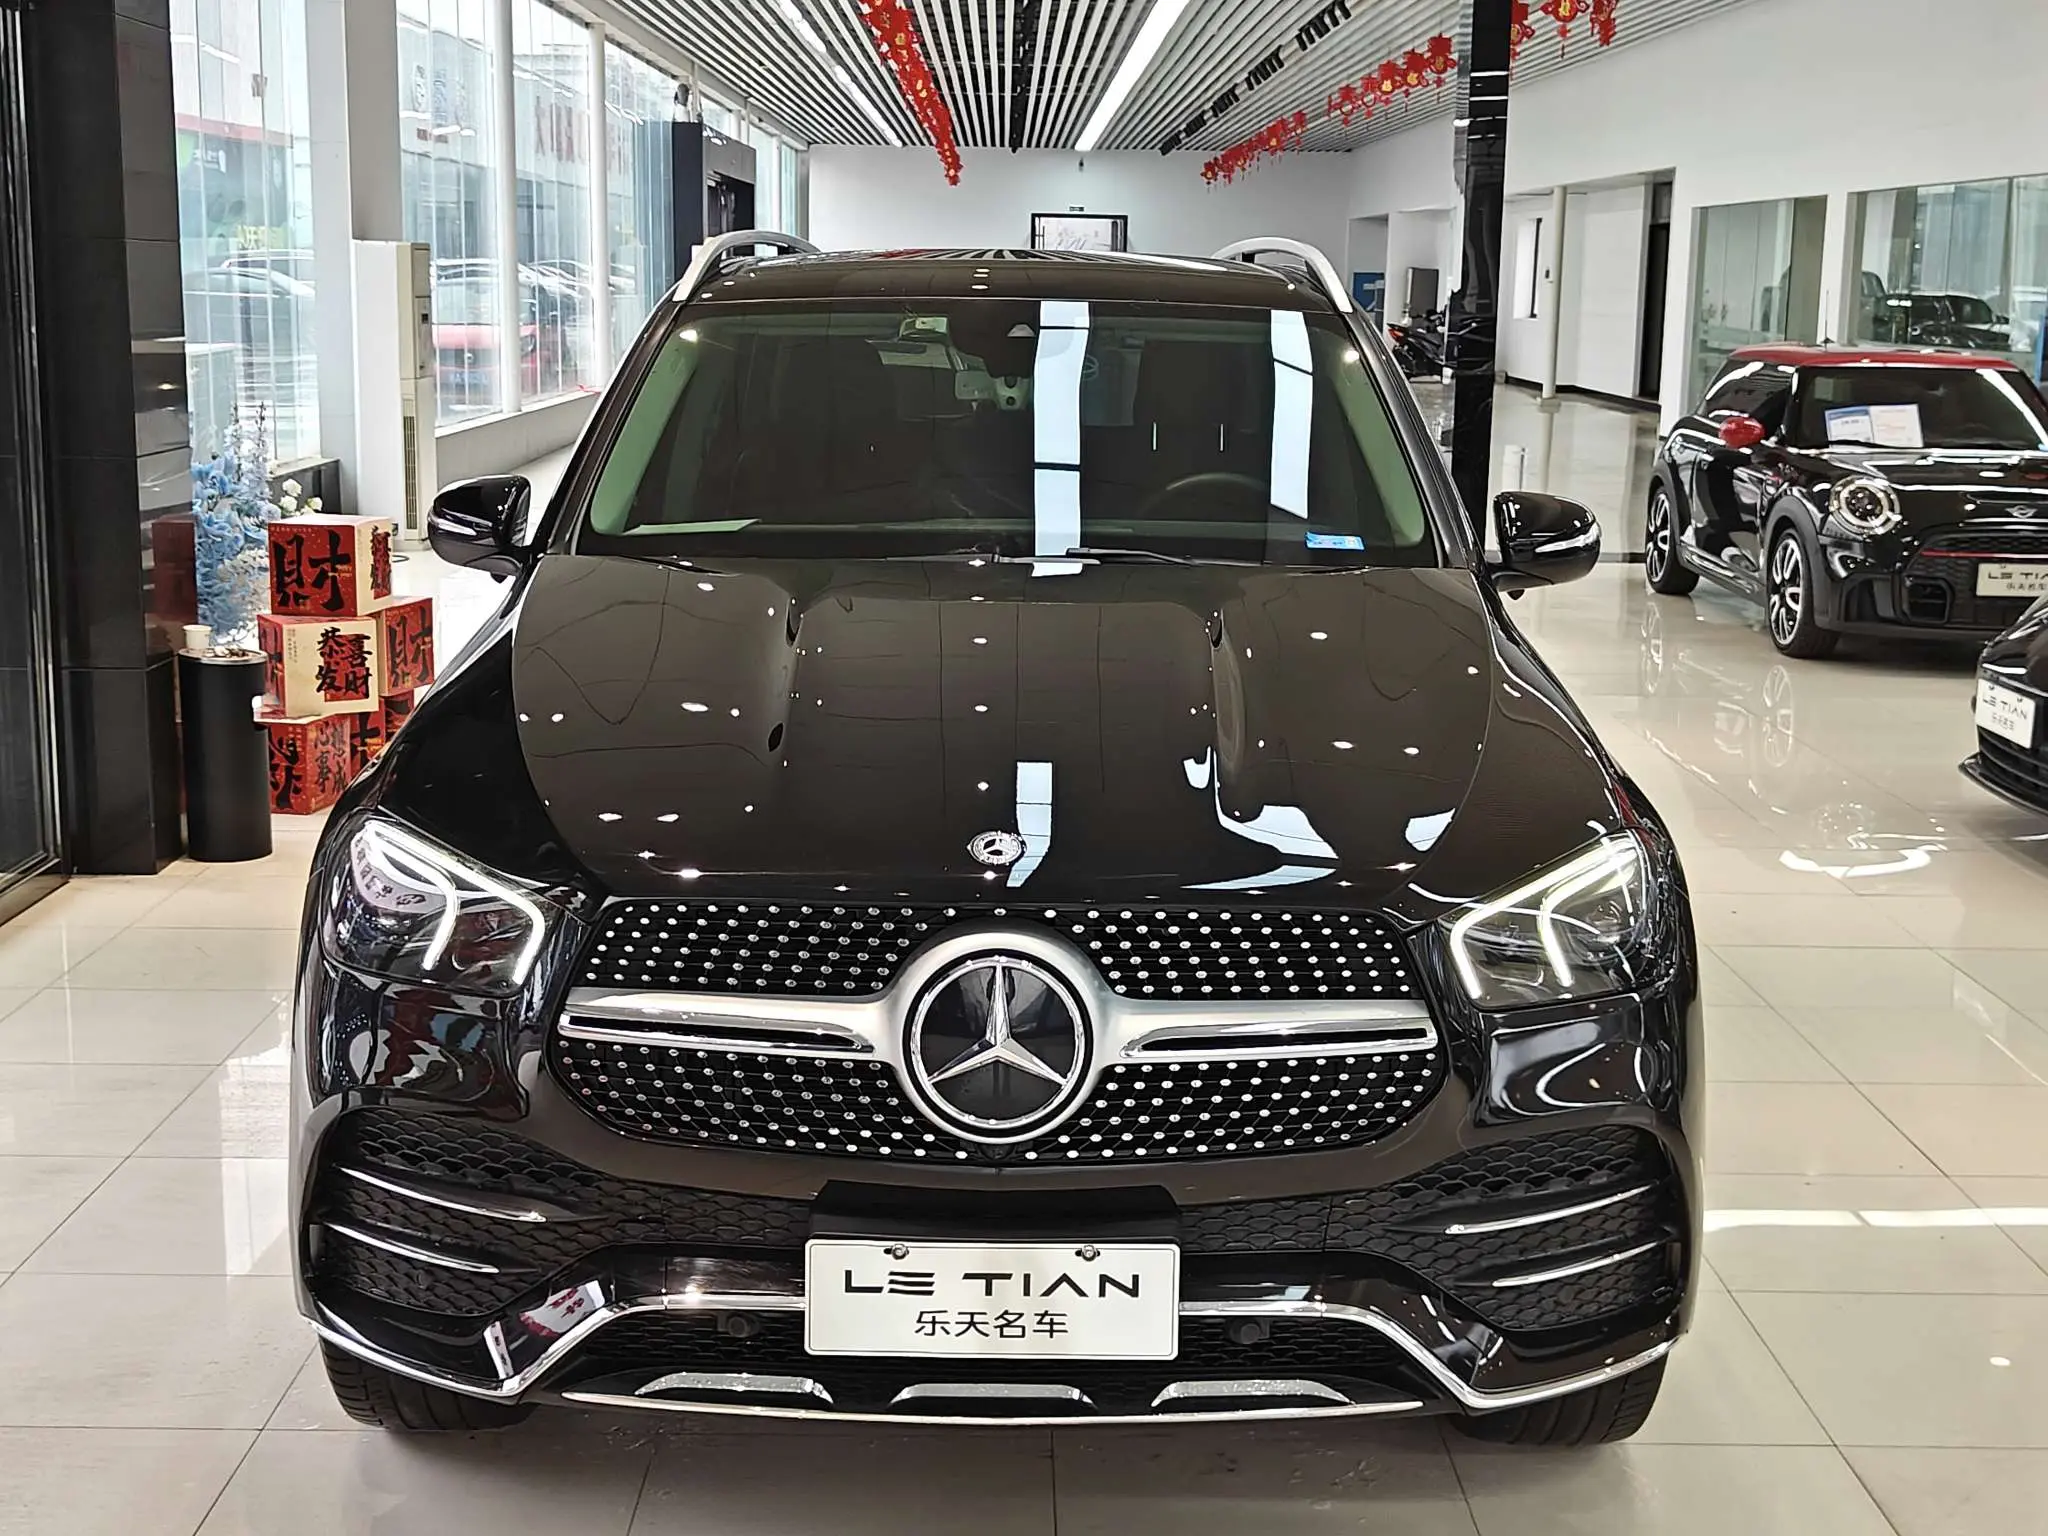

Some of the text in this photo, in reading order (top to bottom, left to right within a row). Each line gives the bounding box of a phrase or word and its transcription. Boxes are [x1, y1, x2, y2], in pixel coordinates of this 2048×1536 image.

[844, 1269, 1140, 1299] LE TIAN
[914, 1309, 1069, 1339] 乐天名车
